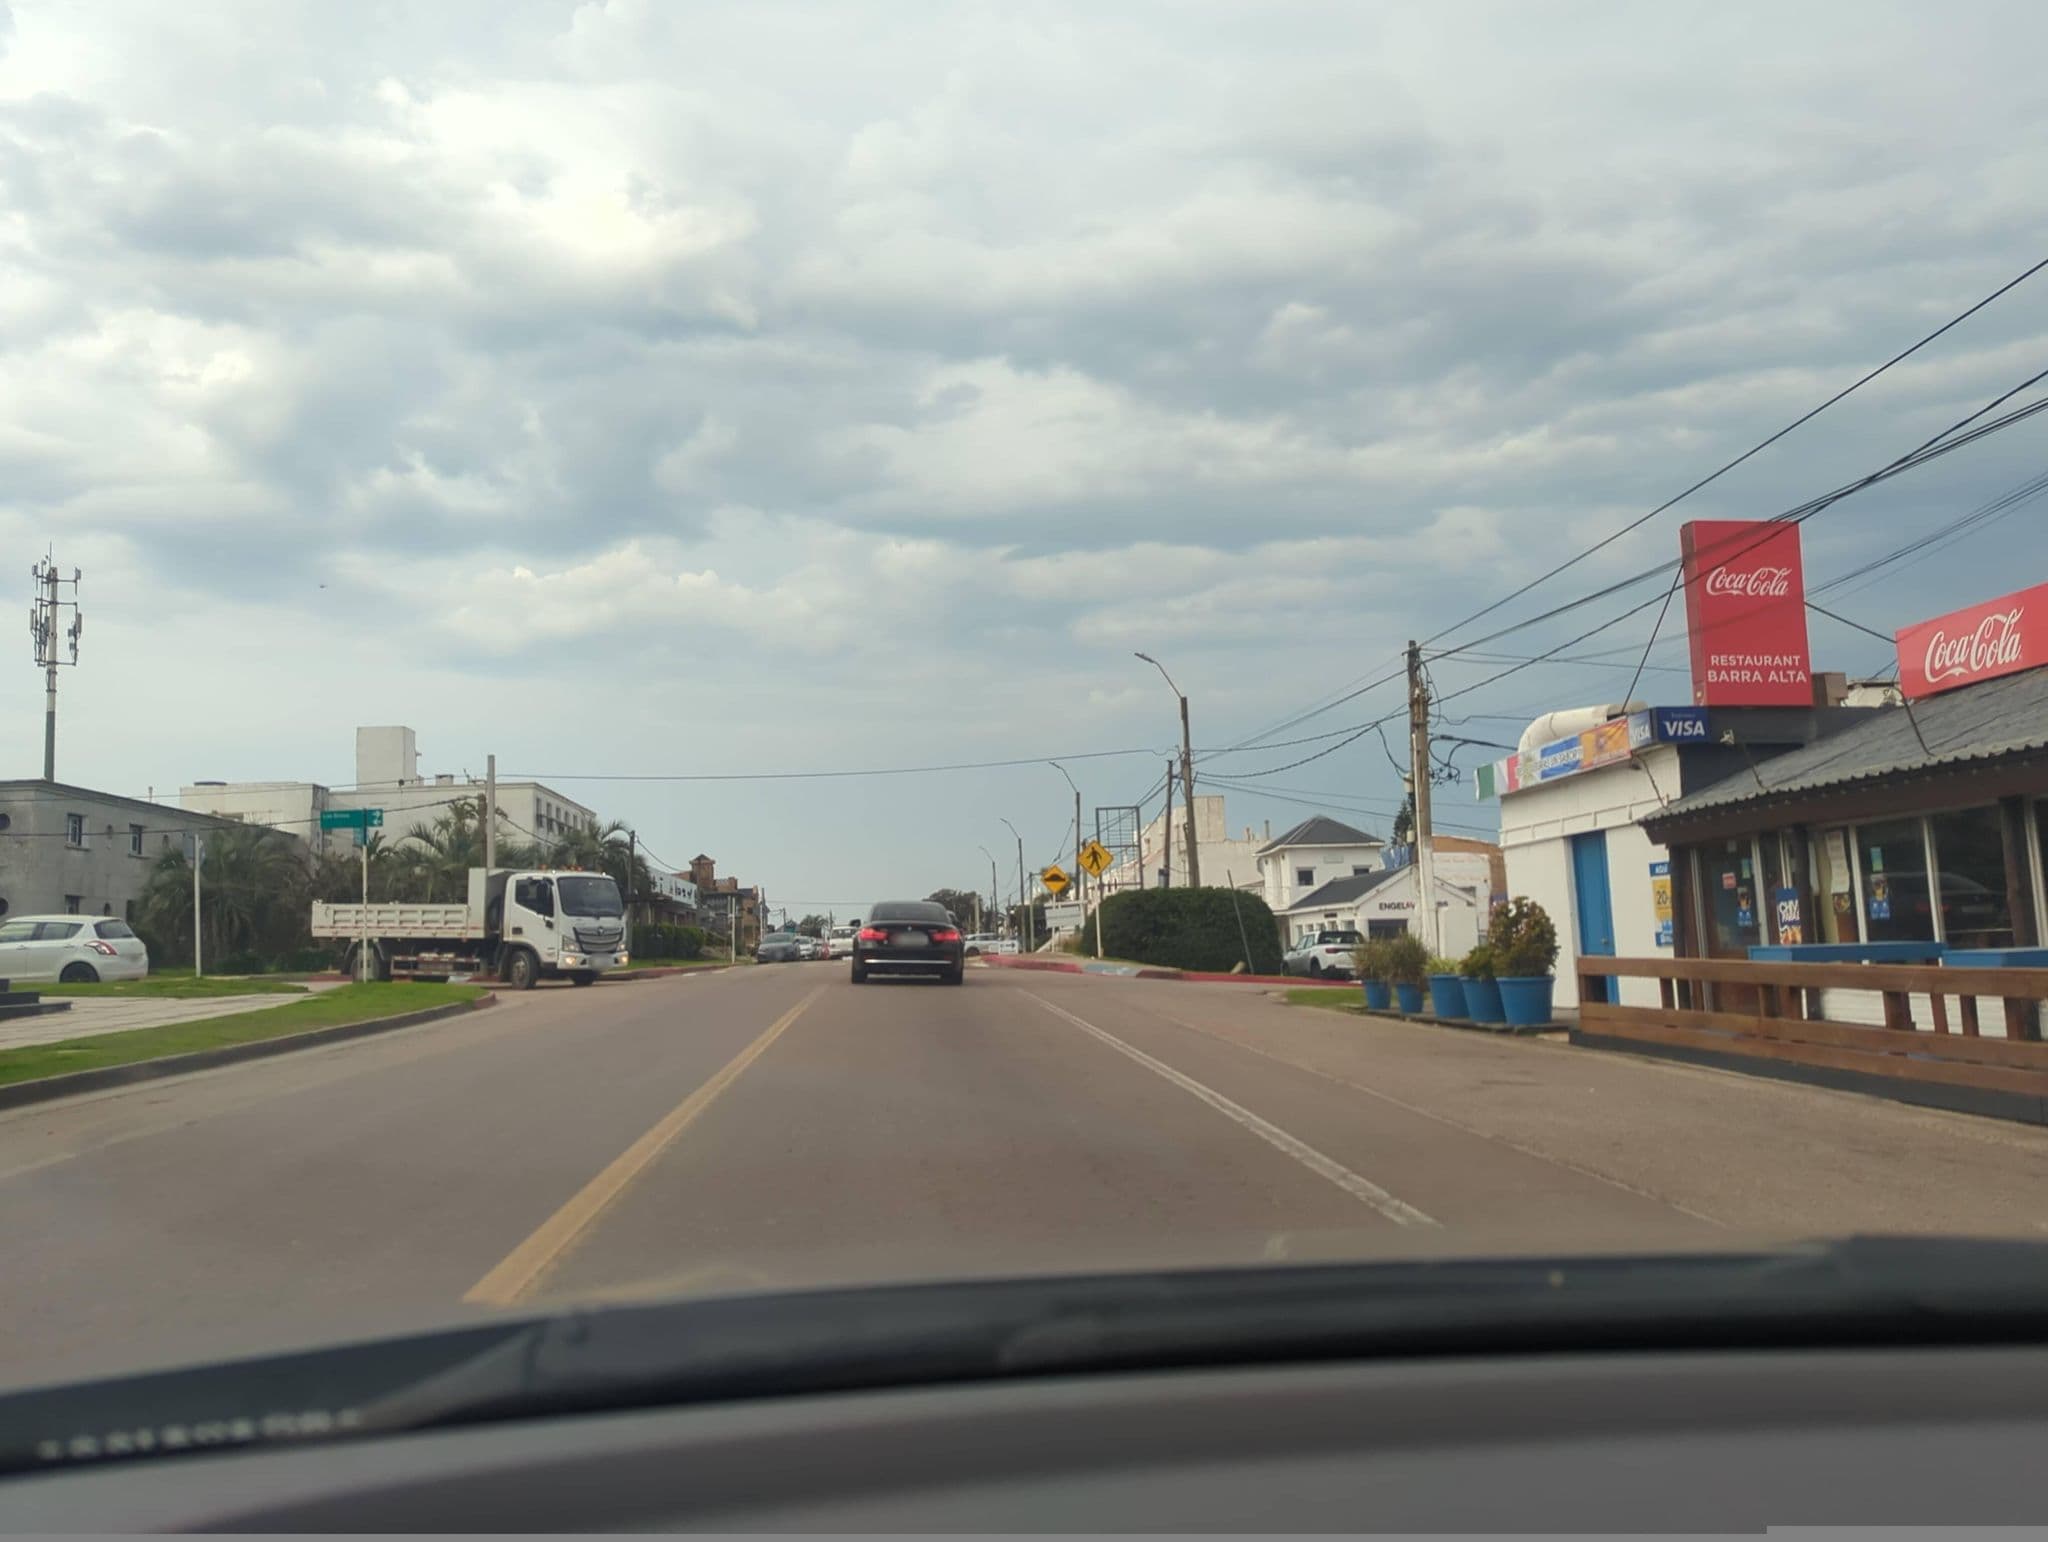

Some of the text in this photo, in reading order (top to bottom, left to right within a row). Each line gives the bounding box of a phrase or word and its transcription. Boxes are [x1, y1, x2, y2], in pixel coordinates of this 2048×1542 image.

[1706, 565, 1792, 596] Coca-Cola
[1924, 605, 2025, 683] Coca-Cola
[1710, 655, 1801, 667] RESTAURANT
[1707, 670, 1807, 683] BARRA ALTA
[1629, 723, 1651, 744] VISA
[1664, 719, 1705, 737] VISA
